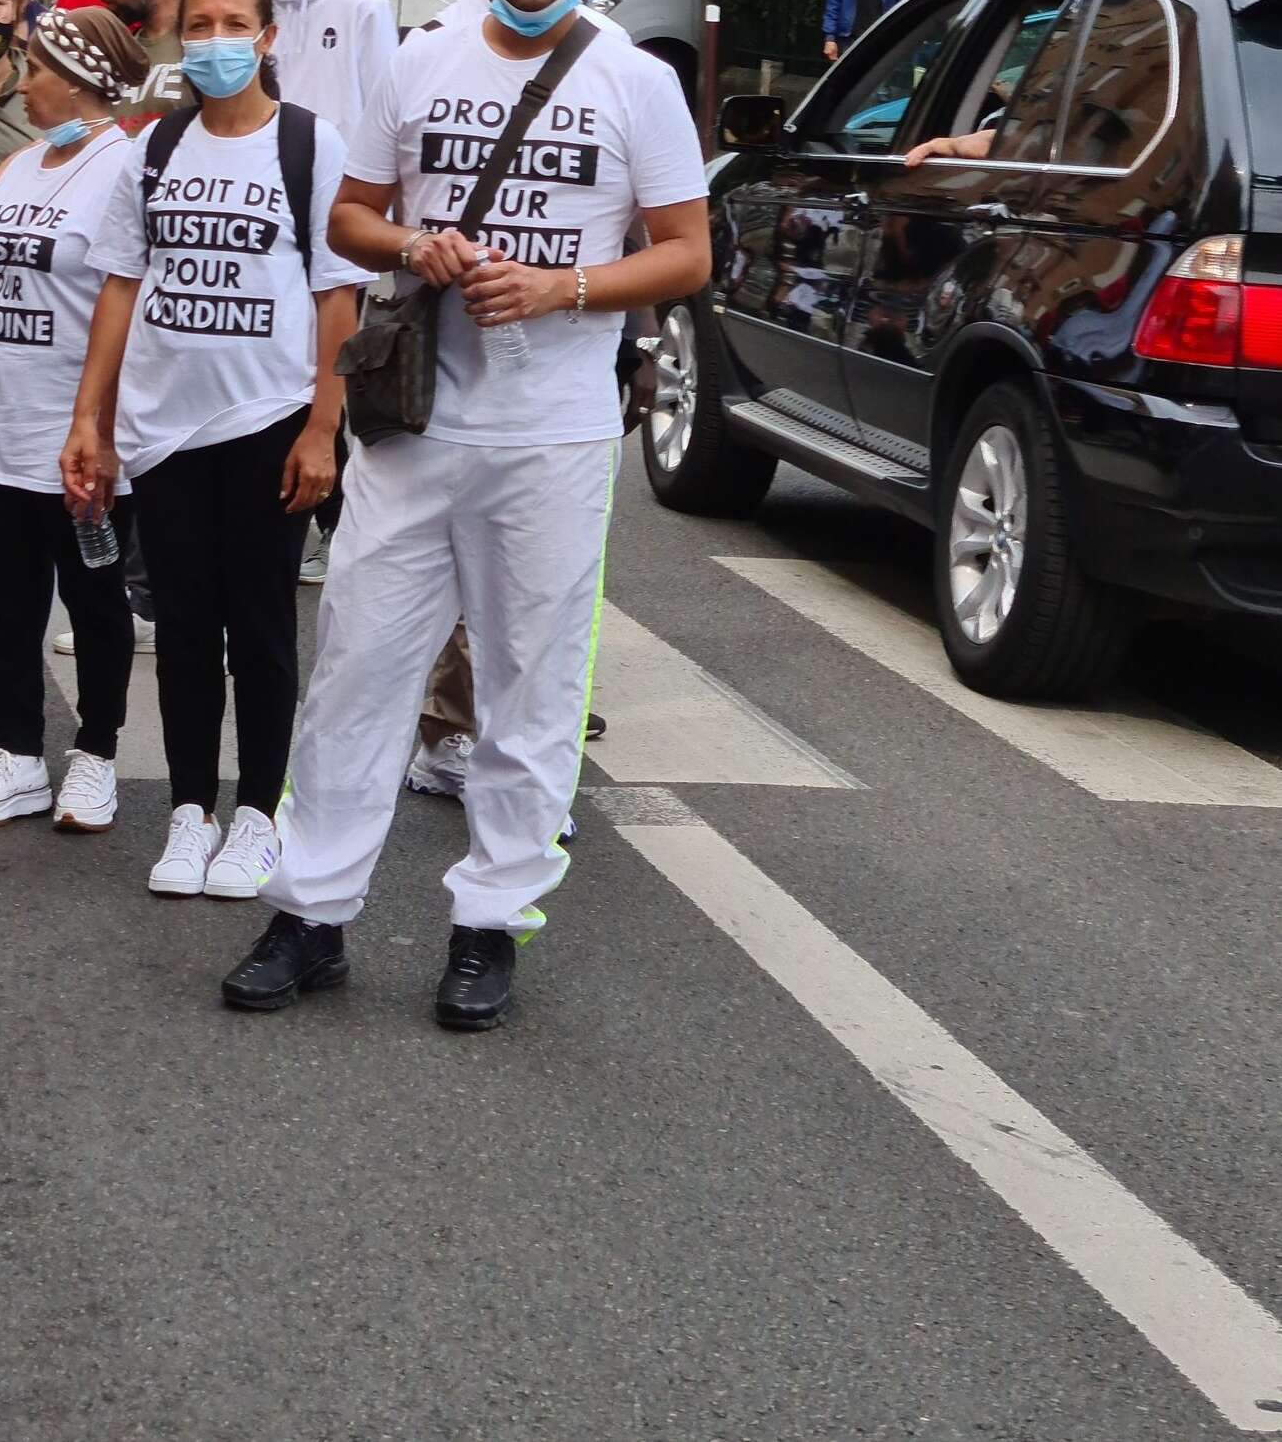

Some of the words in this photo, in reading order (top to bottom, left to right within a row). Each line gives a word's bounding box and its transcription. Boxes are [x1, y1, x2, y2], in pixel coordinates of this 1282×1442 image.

[551, 105, 598, 136] DE
[243, 181, 283, 214] DE
[447, 183, 549, 220] PUR
[36, 207, 69, 229] DE
[161, 257, 242, 289] POUR
